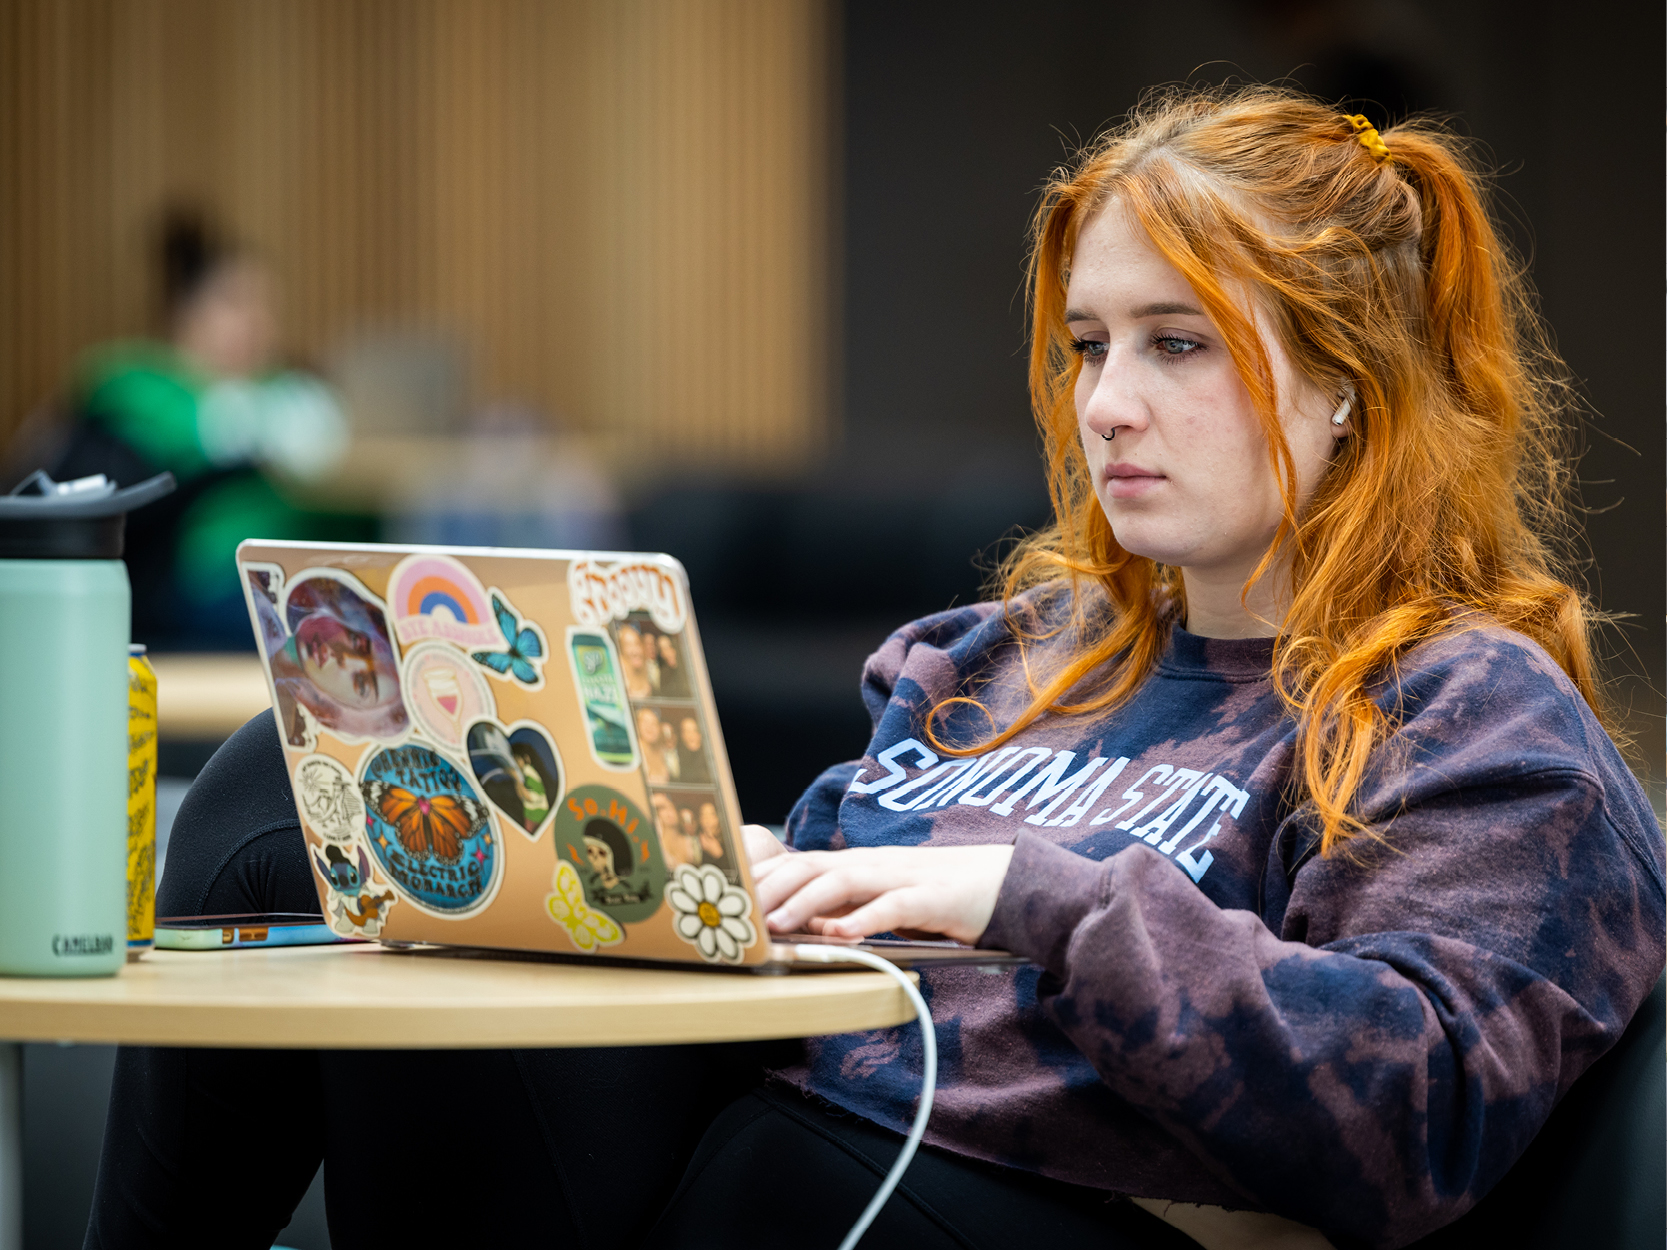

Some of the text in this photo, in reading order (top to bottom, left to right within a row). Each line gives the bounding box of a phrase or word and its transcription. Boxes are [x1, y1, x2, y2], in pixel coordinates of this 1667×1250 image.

[396, 766, 461, 793] TATTOO
[849, 738, 1251, 883] SONOMA STATE
[389, 849, 480, 881] ELECTRIC
[389, 861, 483, 898] MONARCH
